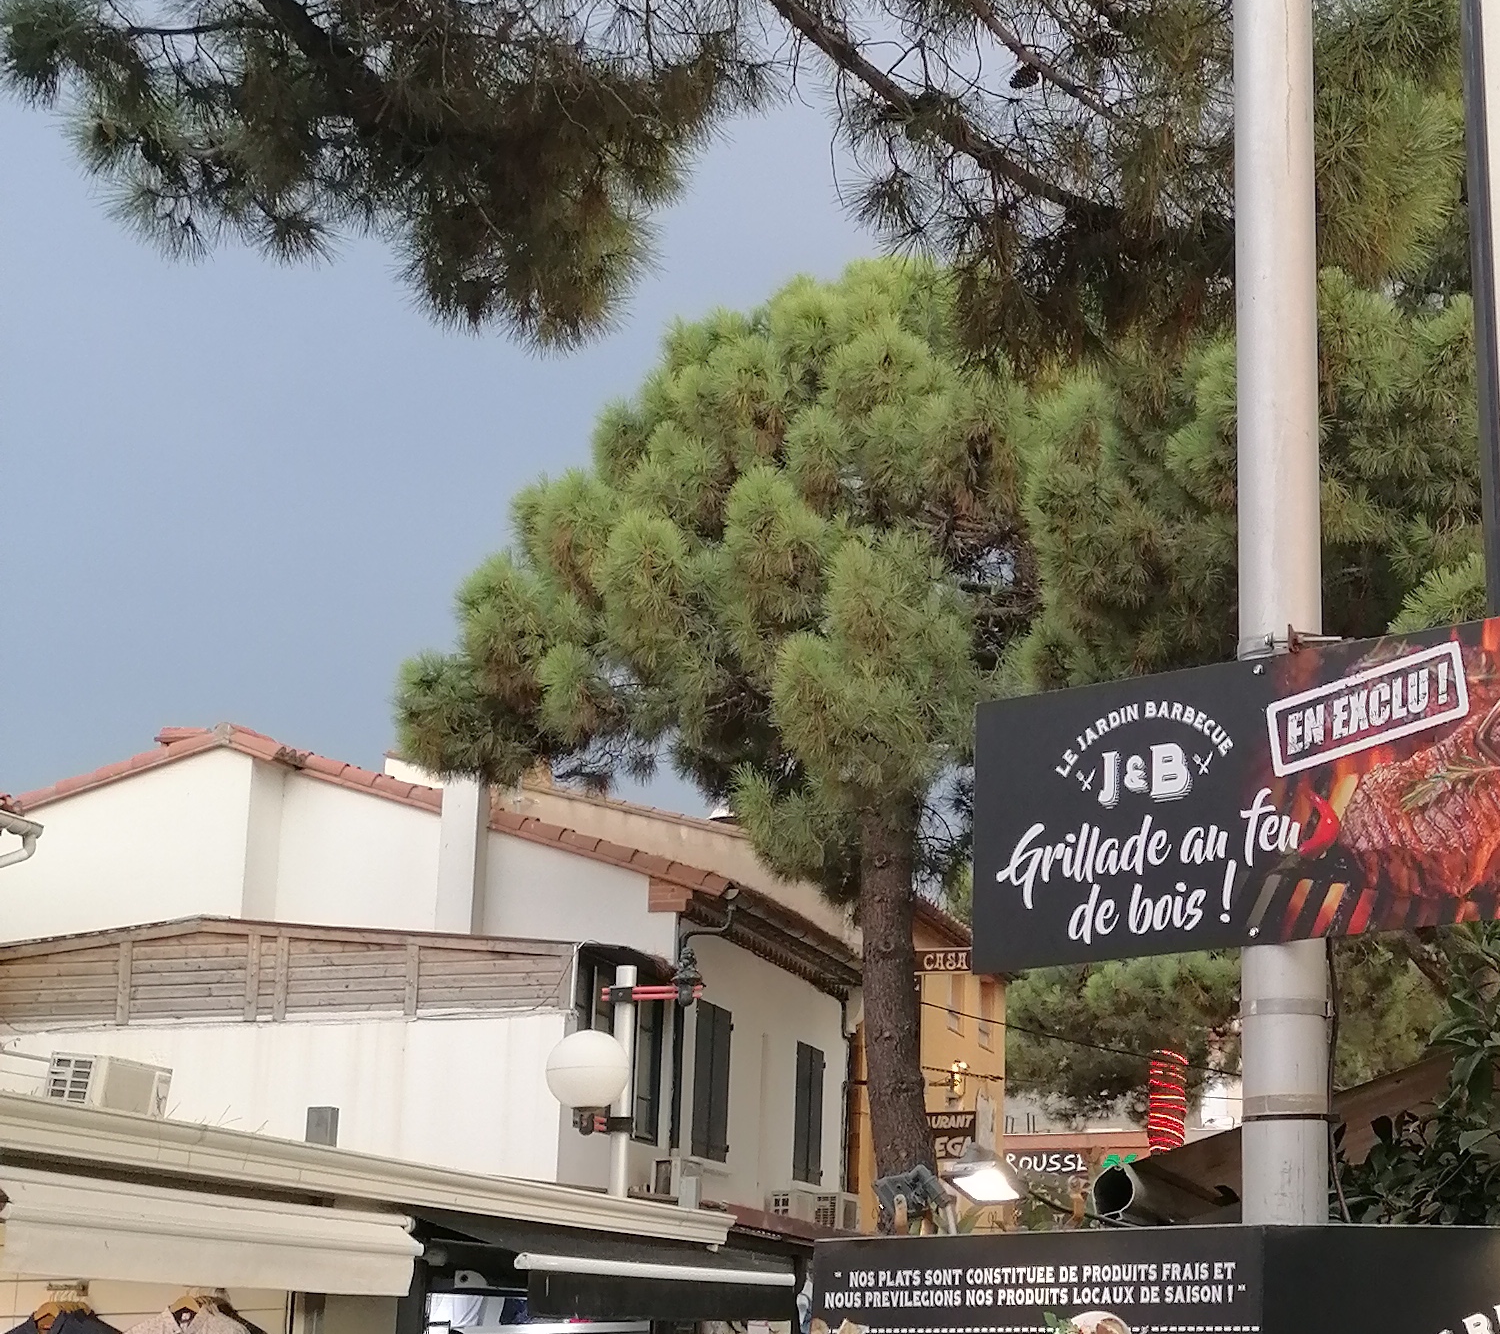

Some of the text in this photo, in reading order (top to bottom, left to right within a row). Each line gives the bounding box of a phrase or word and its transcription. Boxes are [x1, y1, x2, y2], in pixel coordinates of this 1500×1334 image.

[1055, 700, 1234, 779] LE JARDIN BARBECUE
[1286, 713, 1325, 755] EN
[1331, 668, 1433, 742] EXCLU
[996, 787, 1300, 910] Grillade au feu
[1068, 882, 1120, 945] de
[1127, 881, 1206, 936] bois
[923, 952, 969, 971] CASA
[824, 1291, 862, 1309] NOUS
[966, 1289, 993, 1307] NOS
[998, 1287, 1068, 1306] PRODUITS
[1072, 1285, 1135, 1306] LOCAUX
[1140, 1285, 1160, 1304] DE
[1164, 1284, 1223, 1304] SAISON
[850, 1262, 1236, 1288] NOS PLATS SONT CONSTITUEE DE PRODUITS FRAIS ET
